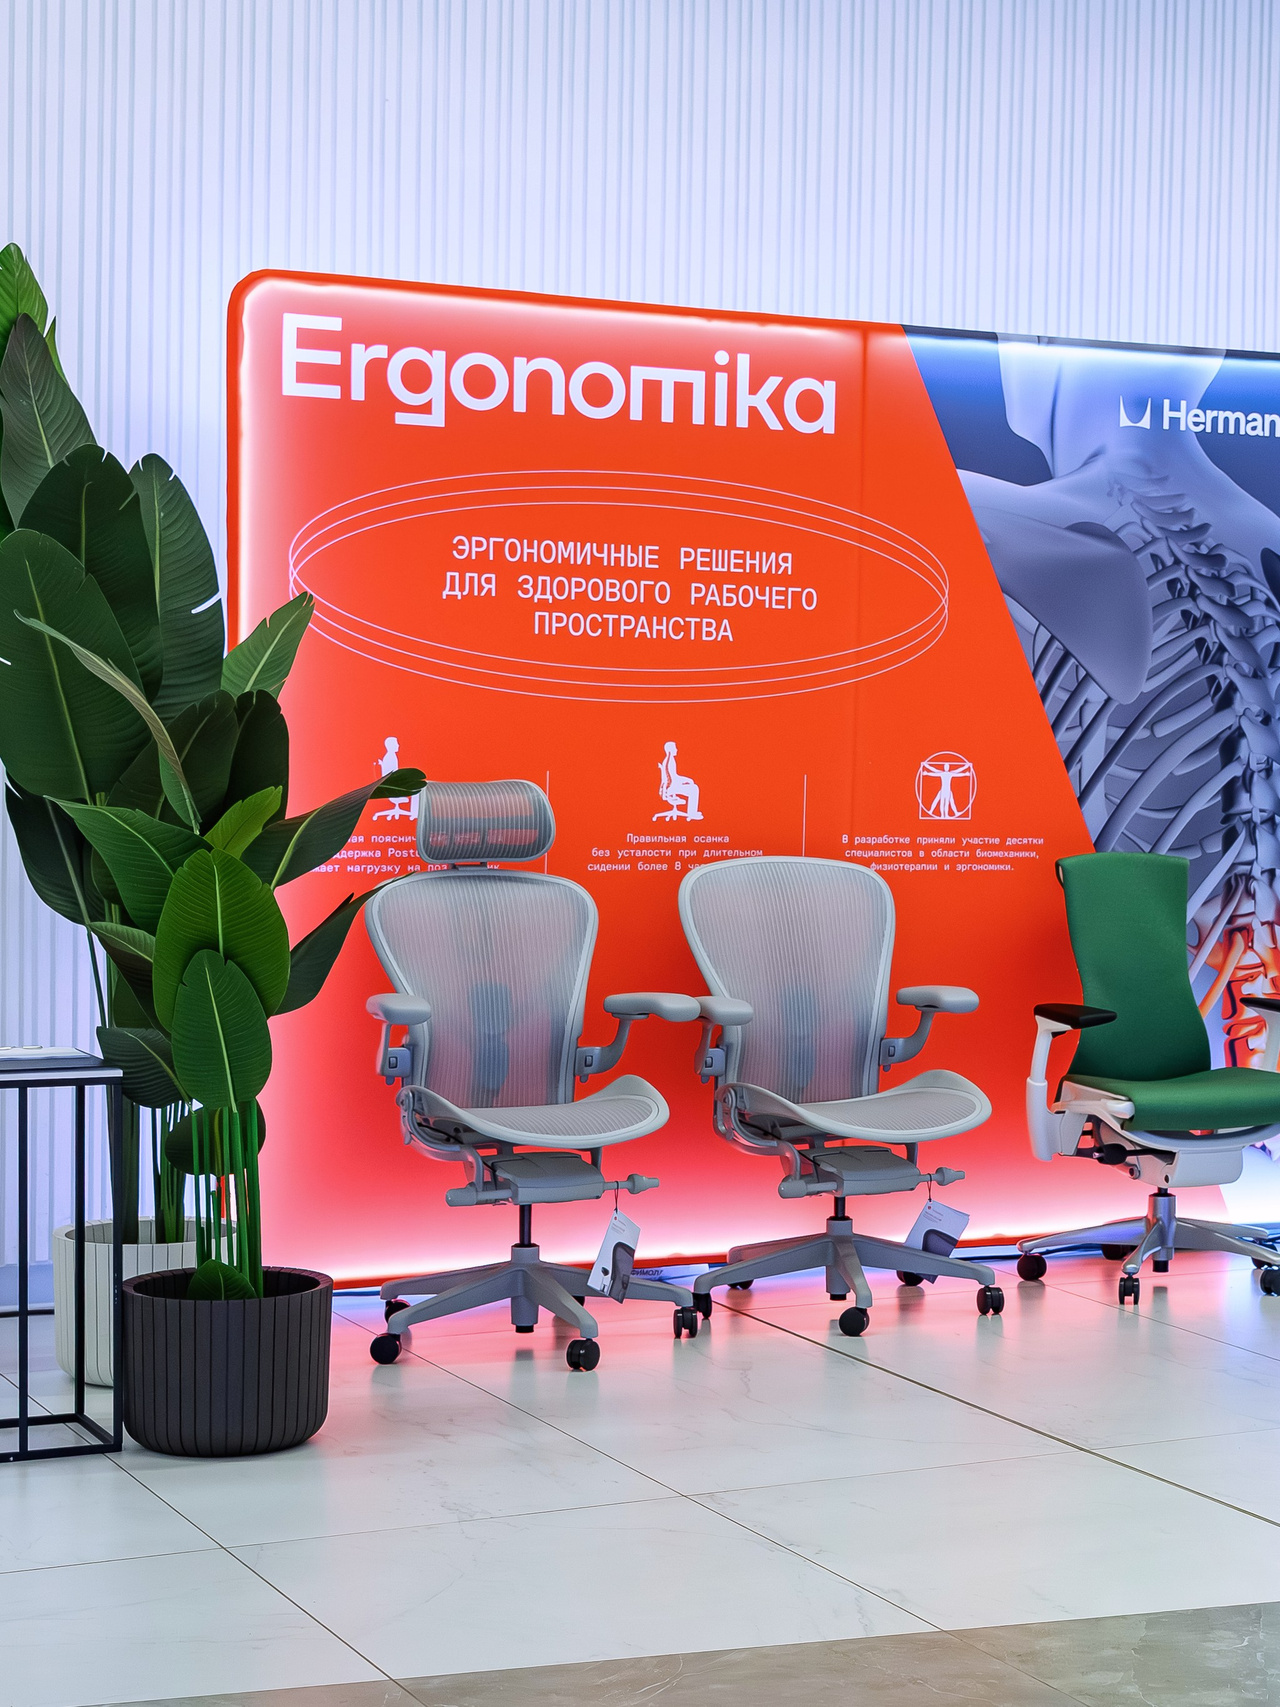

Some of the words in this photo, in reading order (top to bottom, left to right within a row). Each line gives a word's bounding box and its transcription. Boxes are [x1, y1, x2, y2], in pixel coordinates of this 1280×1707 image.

[281, 312, 837, 435] Ergonomika
[452, 535, 660, 569] ЭРГОНОМИЧНЫЕ
[680, 547, 793, 575] РЕШЕНИЯ
[442, 571, 496, 600] ДЛЯ
[517, 574, 671, 605] ЗДОРОВОГО
[690, 582, 818, 611] РАБОЧЕГО
[534, 611, 734, 642] ПРОСТРАНСТВА
[626, 833, 687, 845] Правильная
[693, 835, 730, 843] осанка
[841, 834, 849, 844] В
[854, 835, 911, 845] разработке
[916, 836, 956, 846] приняли
[962, 837, 1000, 846] участие
[1005, 837, 1044, 846] десятки
[591, 847, 610, 857] без
[617, 848, 672, 858] усталости
[678, 849, 697, 859] при
[703, 849, 763, 858] длительном
[844, 849, 913, 859] специалистов
[919, 850, 925, 858] в
[931, 848, 970, 858] области
[975, 849, 1040, 860] биомеханики,
[347, 864, 401, 875] нагрузку
[587, 863, 631, 872] сидении
[637, 861, 668, 871] более
[674, 861, 682, 871] 8
[870, 862, 938, 873] физиотерапии
[955, 864, 1015, 873] эргономики.
